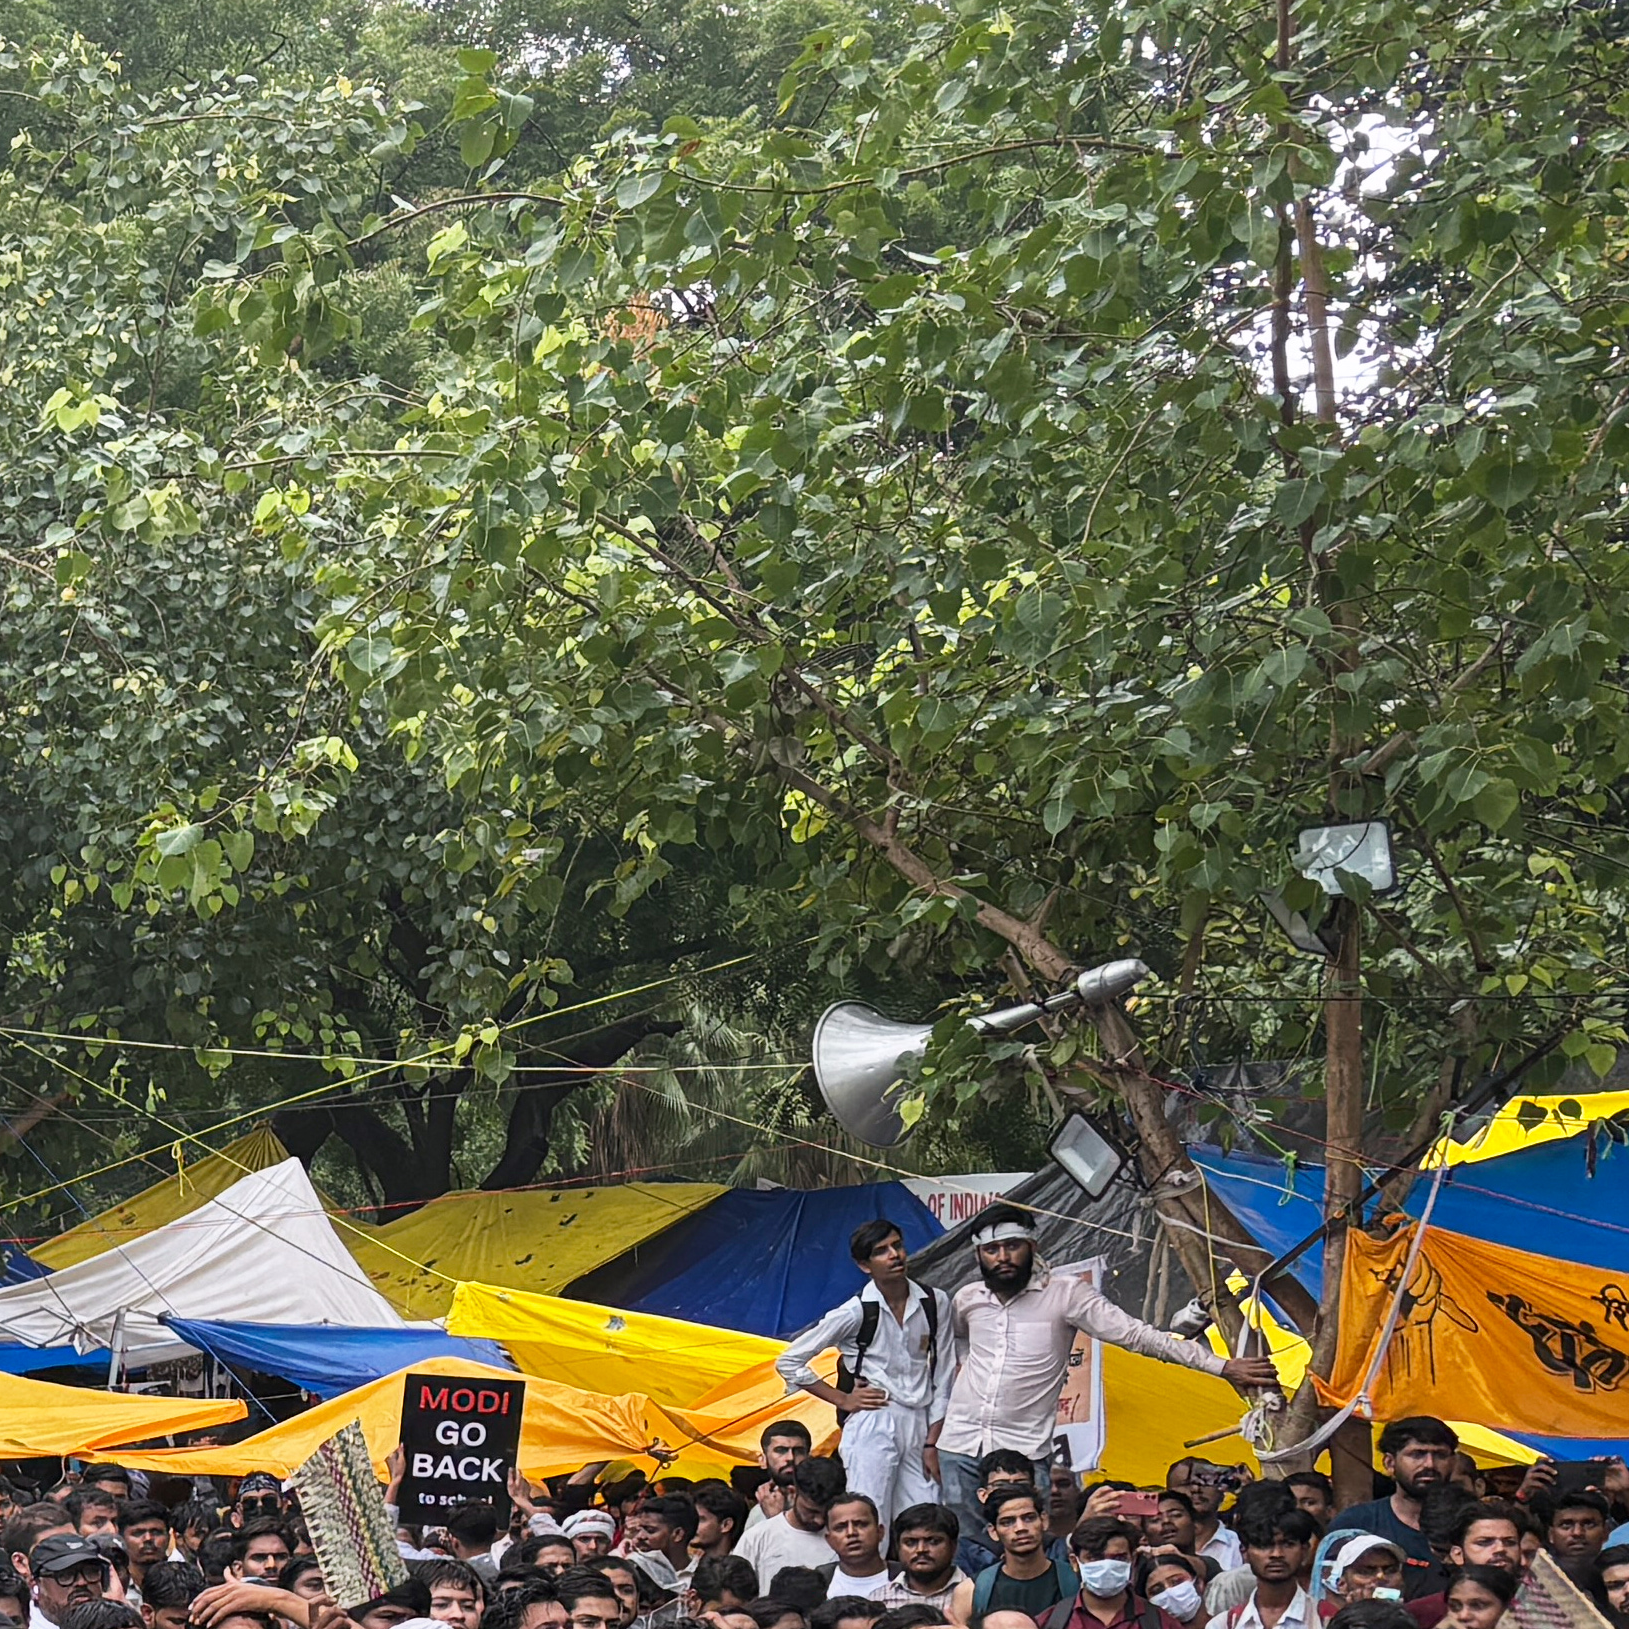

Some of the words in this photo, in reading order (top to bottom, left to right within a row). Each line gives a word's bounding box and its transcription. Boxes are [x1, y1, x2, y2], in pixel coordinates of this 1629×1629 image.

[928, 1193, 945, 1220] OF
[419, 1386, 510, 1415] MODI
[435, 1420, 487, 1447] GO
[412, 1453, 504, 1483] BACK
[418, 1492, 436, 1505] to
